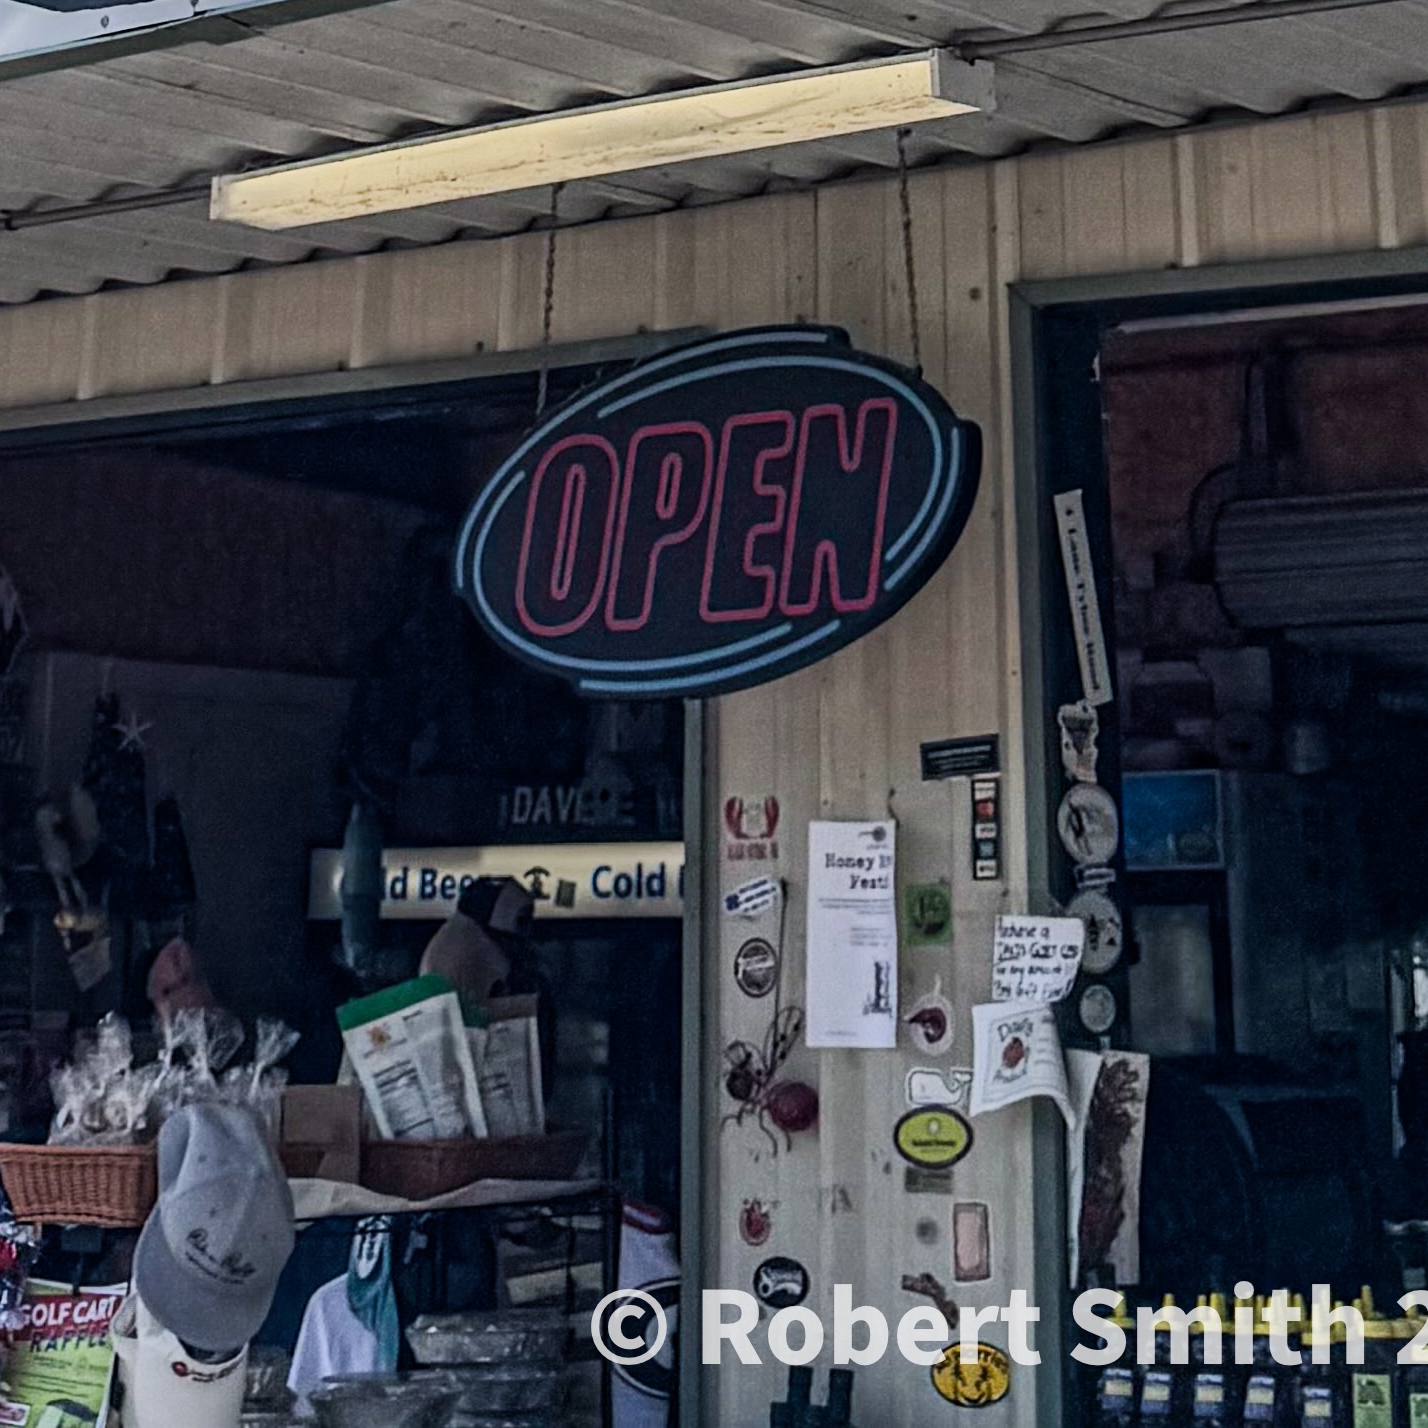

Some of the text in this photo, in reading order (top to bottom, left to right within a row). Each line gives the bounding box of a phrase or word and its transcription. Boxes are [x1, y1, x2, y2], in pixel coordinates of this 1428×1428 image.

[515, 397, 898, 638] OPEN
[825, 852, 876, 872] Honey
[420, 867, 474, 900] Bee
[591, 862, 667, 901] Cold
[20, 1295, 117, 1327] GOLF CART
